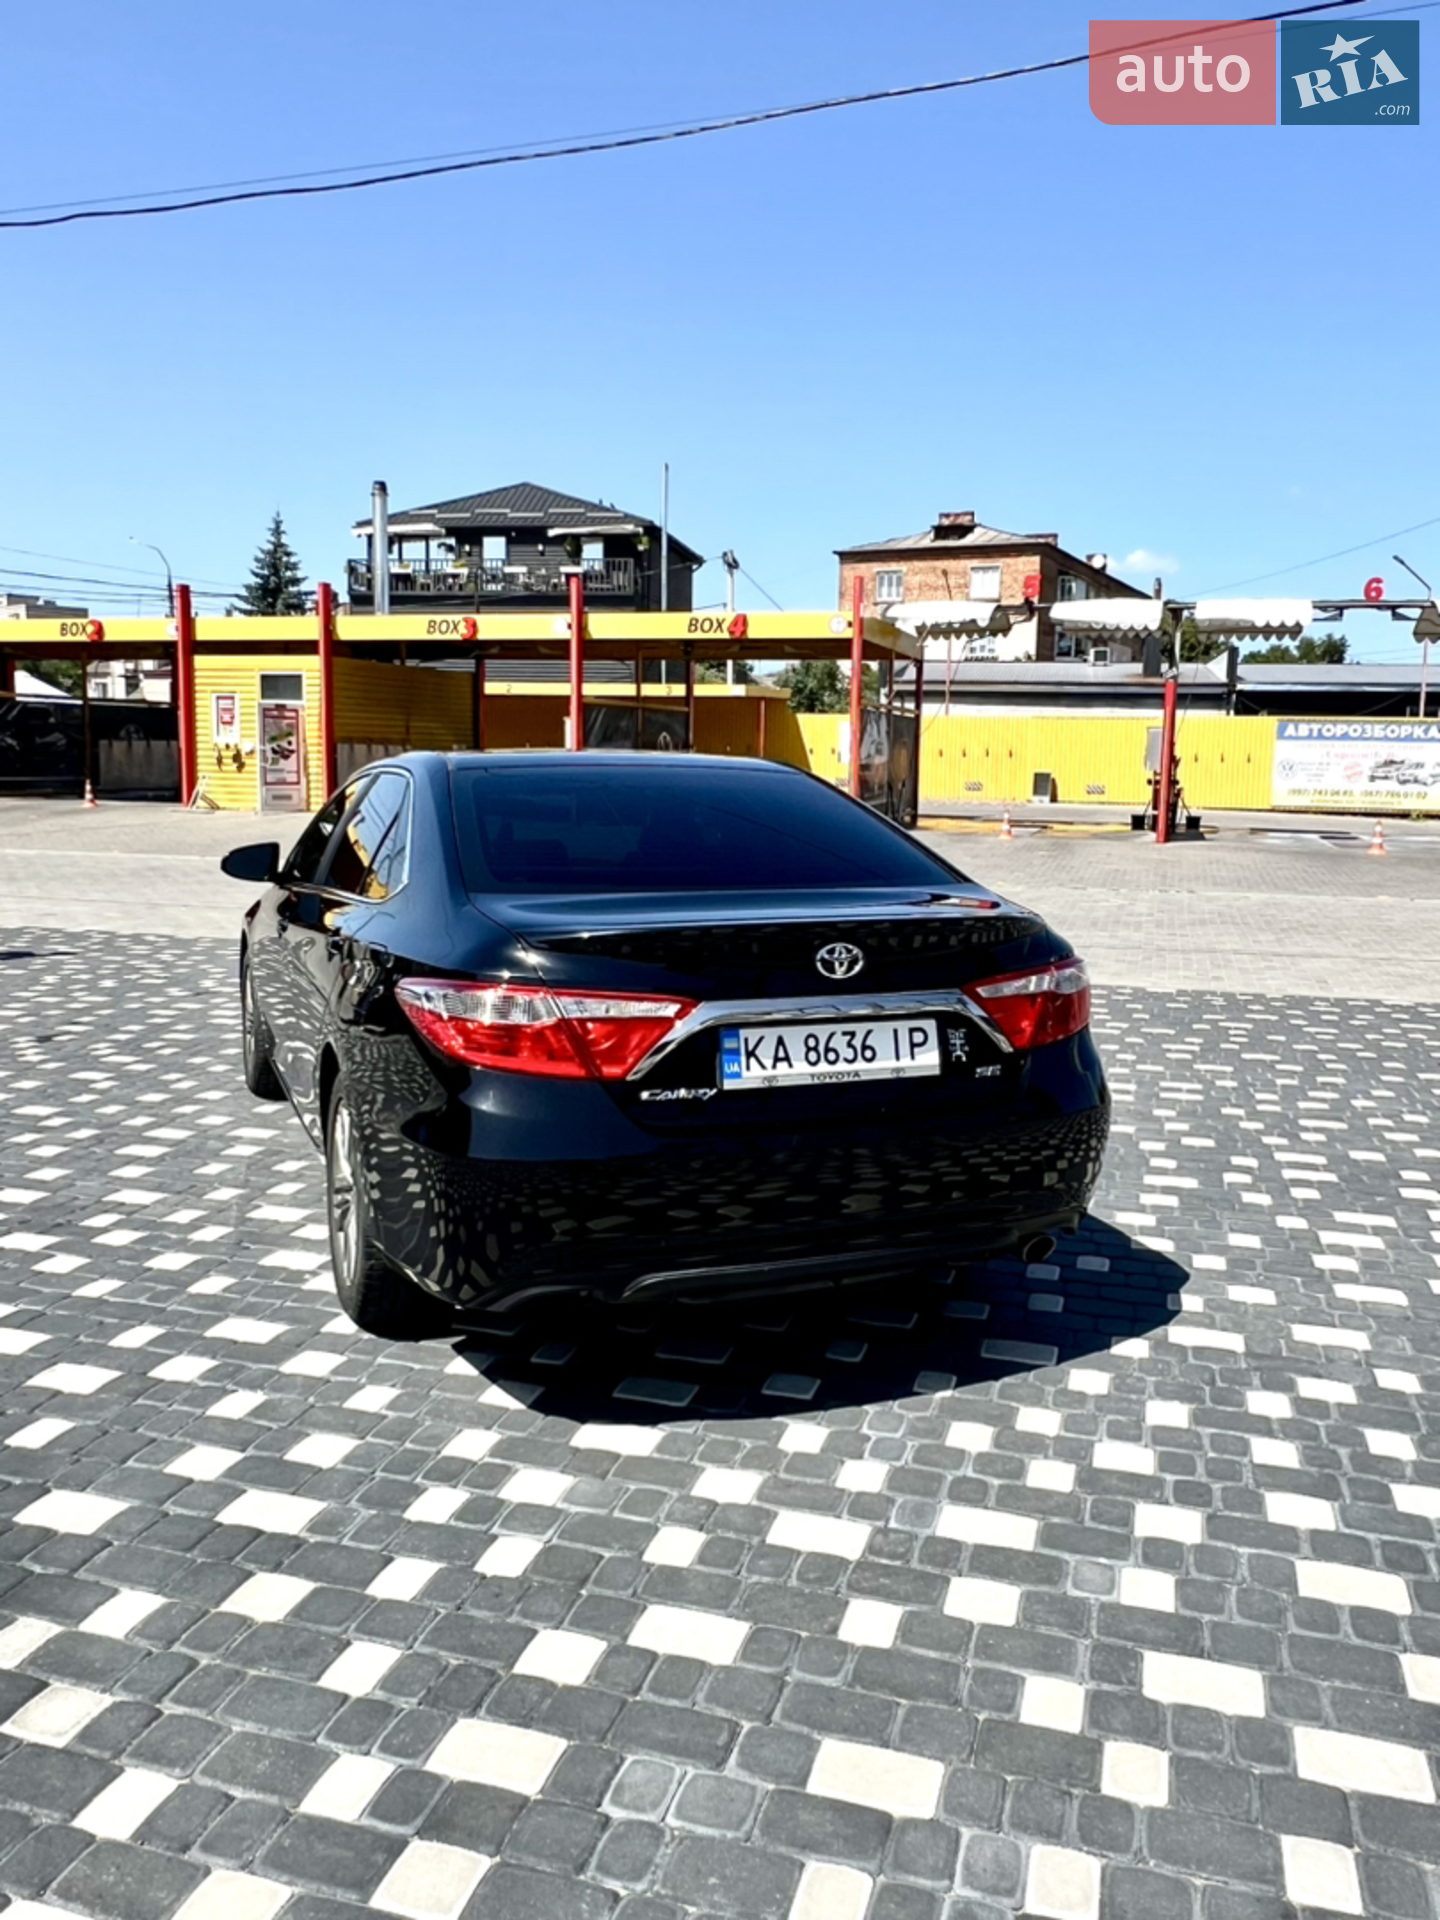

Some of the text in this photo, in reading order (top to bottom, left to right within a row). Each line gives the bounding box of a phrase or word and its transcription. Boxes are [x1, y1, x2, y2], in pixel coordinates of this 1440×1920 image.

[1363, 577, 1384, 602] 6
[427, 619, 461, 635] BOX
[688, 613, 749, 640] BOX 4
[1284, 723, 1440, 739] АВТОРОЗБОРКА
[743, 1034, 794, 1072] KA
[804, 1029, 877, 1067] 8636
[892, 1026, 929, 1062] IP
[724, 1062, 741, 1074] UA
[808, 1071, 862, 1083] TOYOTA
